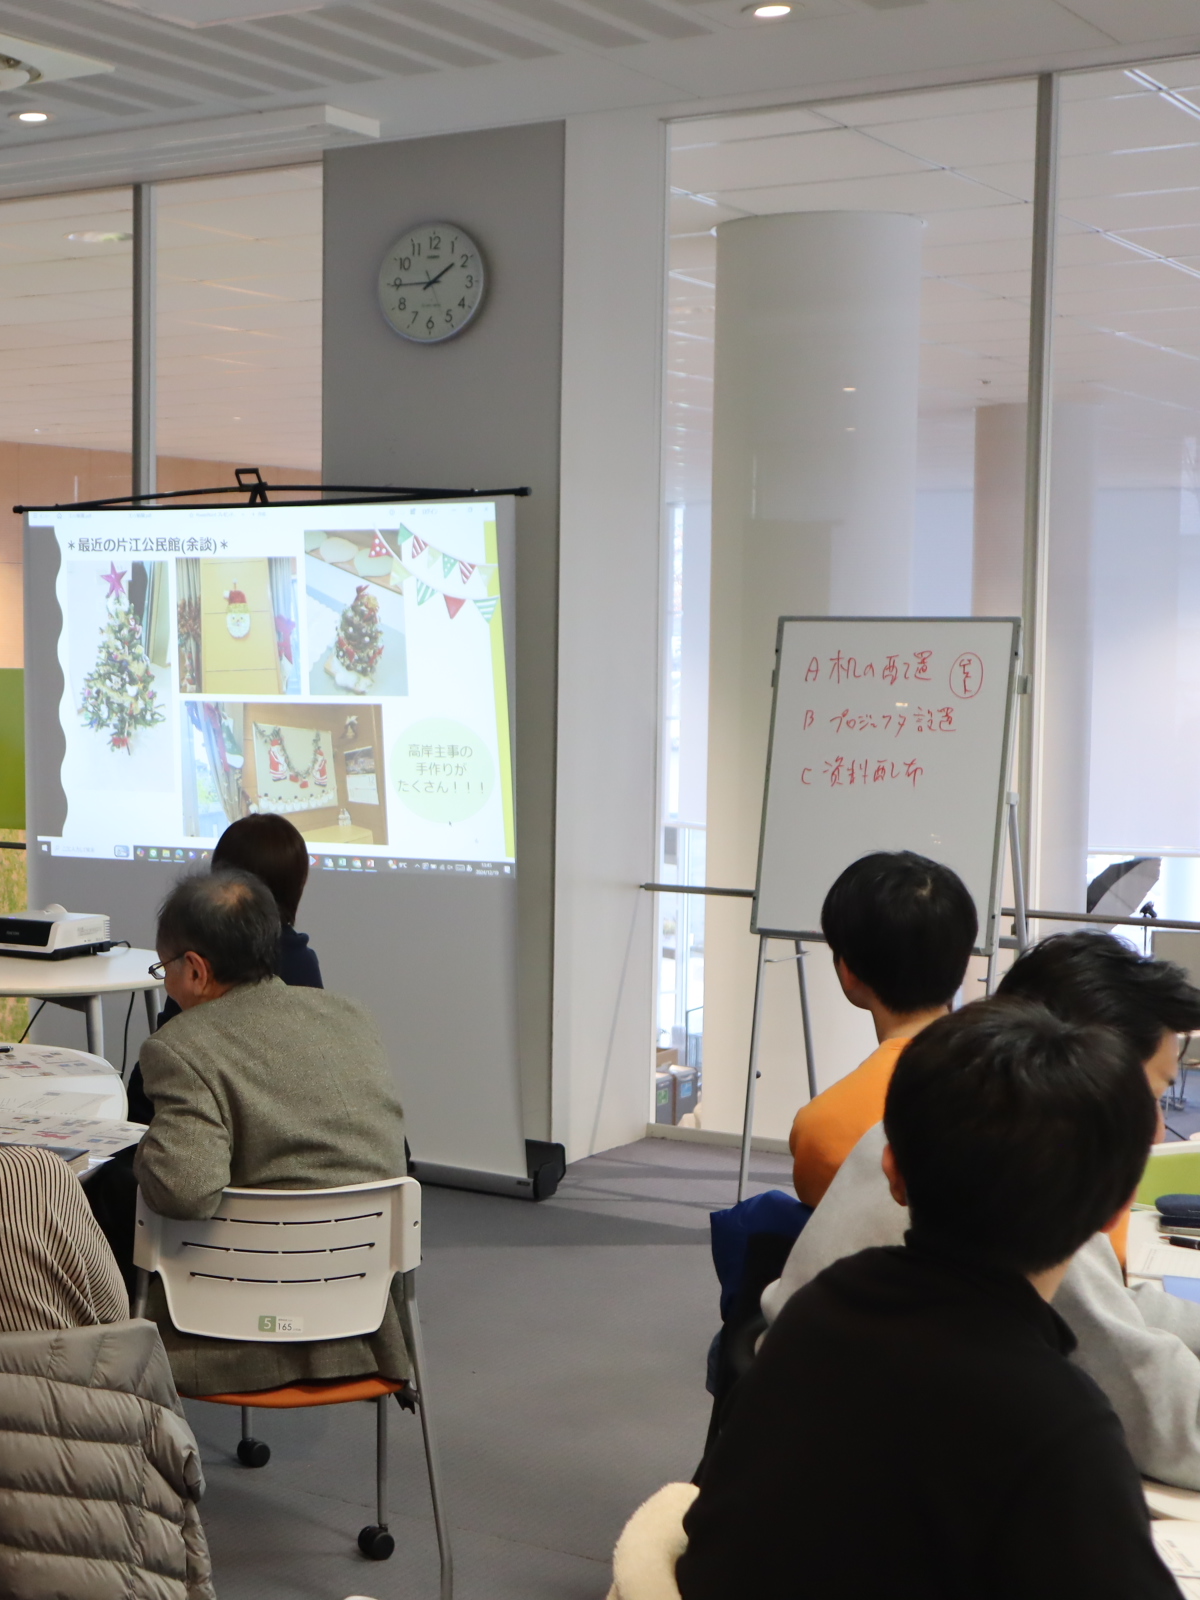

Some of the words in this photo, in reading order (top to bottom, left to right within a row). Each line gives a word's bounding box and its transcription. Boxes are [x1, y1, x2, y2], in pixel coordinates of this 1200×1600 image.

[412, 242, 421, 256] 11
[429, 236, 441, 250] 12
[399, 256, 411, 271] 10
[460, 254, 469, 268] 2
[393, 277, 402, 291] 9
[465, 275, 474, 289] 3
[398, 297, 406, 311] 8
[457, 296, 465, 309] 4
[411, 311, 419, 324] 7
[426, 315, 435, 330] 6
[444, 309, 453, 323] 5
[804, 656, 819, 682] A
[803, 709, 815, 731] B
[408, 743, 473, 758] 高岸主事の
[416, 762, 467, 776] 手作りが
[263, 1317, 272, 1329] 5
[278, 1322, 292, 1331] 165
